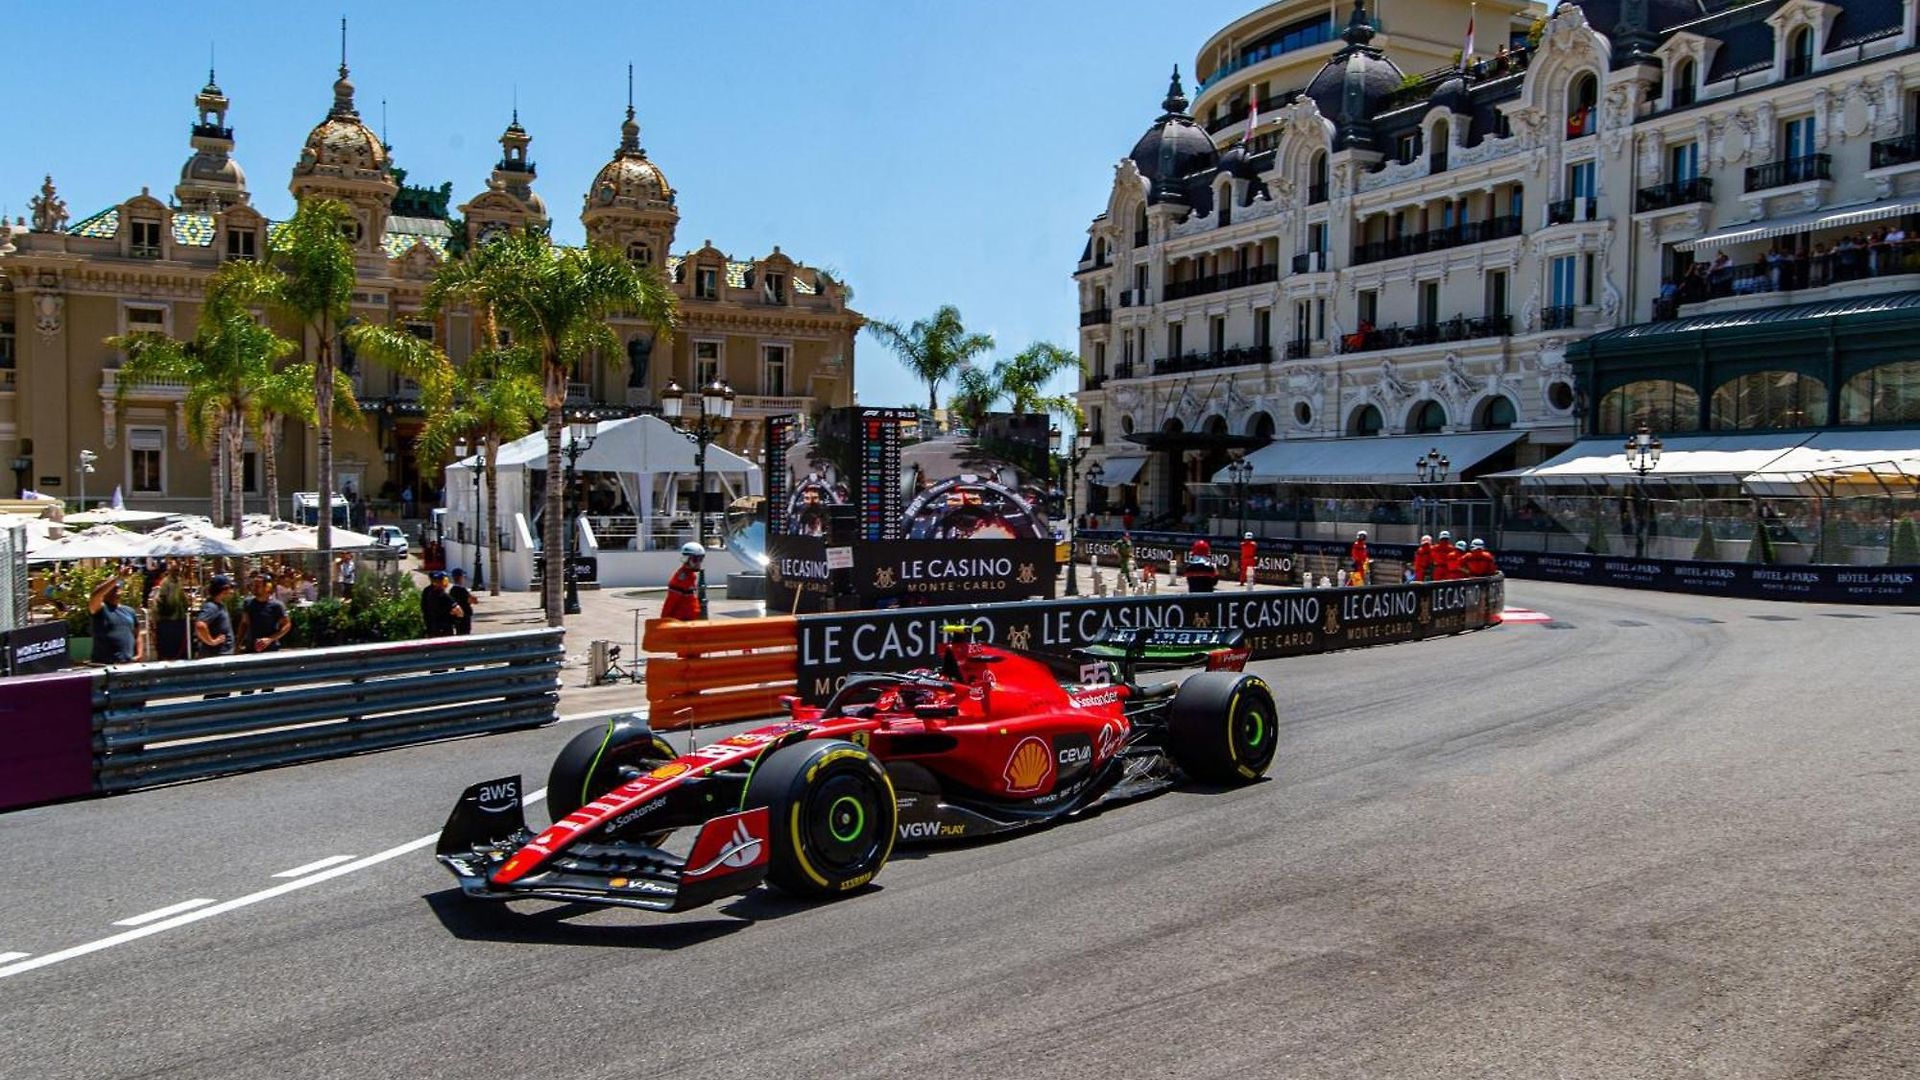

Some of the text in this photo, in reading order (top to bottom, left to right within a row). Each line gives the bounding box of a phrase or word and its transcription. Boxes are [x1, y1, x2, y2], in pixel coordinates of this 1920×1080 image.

[782, 559, 830, 579] LE CASINO
[901, 558, 1012, 579] LE CASINO
[1254, 556, 1291, 572] ASINO
[1343, 591, 1416, 620] LE CASINO
[1432, 588, 1443, 611] LE
[1217, 597, 1319, 629] LE CASINO
[1043, 611, 1072, 645] LE
[803, 626, 842, 666] LE
[1080, 660, 1112, 690] 55
[1076, 690, 1119, 708] Santander
[479, 782, 516, 802] aws
[615, 796, 667, 829] Santander
[628, 880, 678, 895] V-Pow
